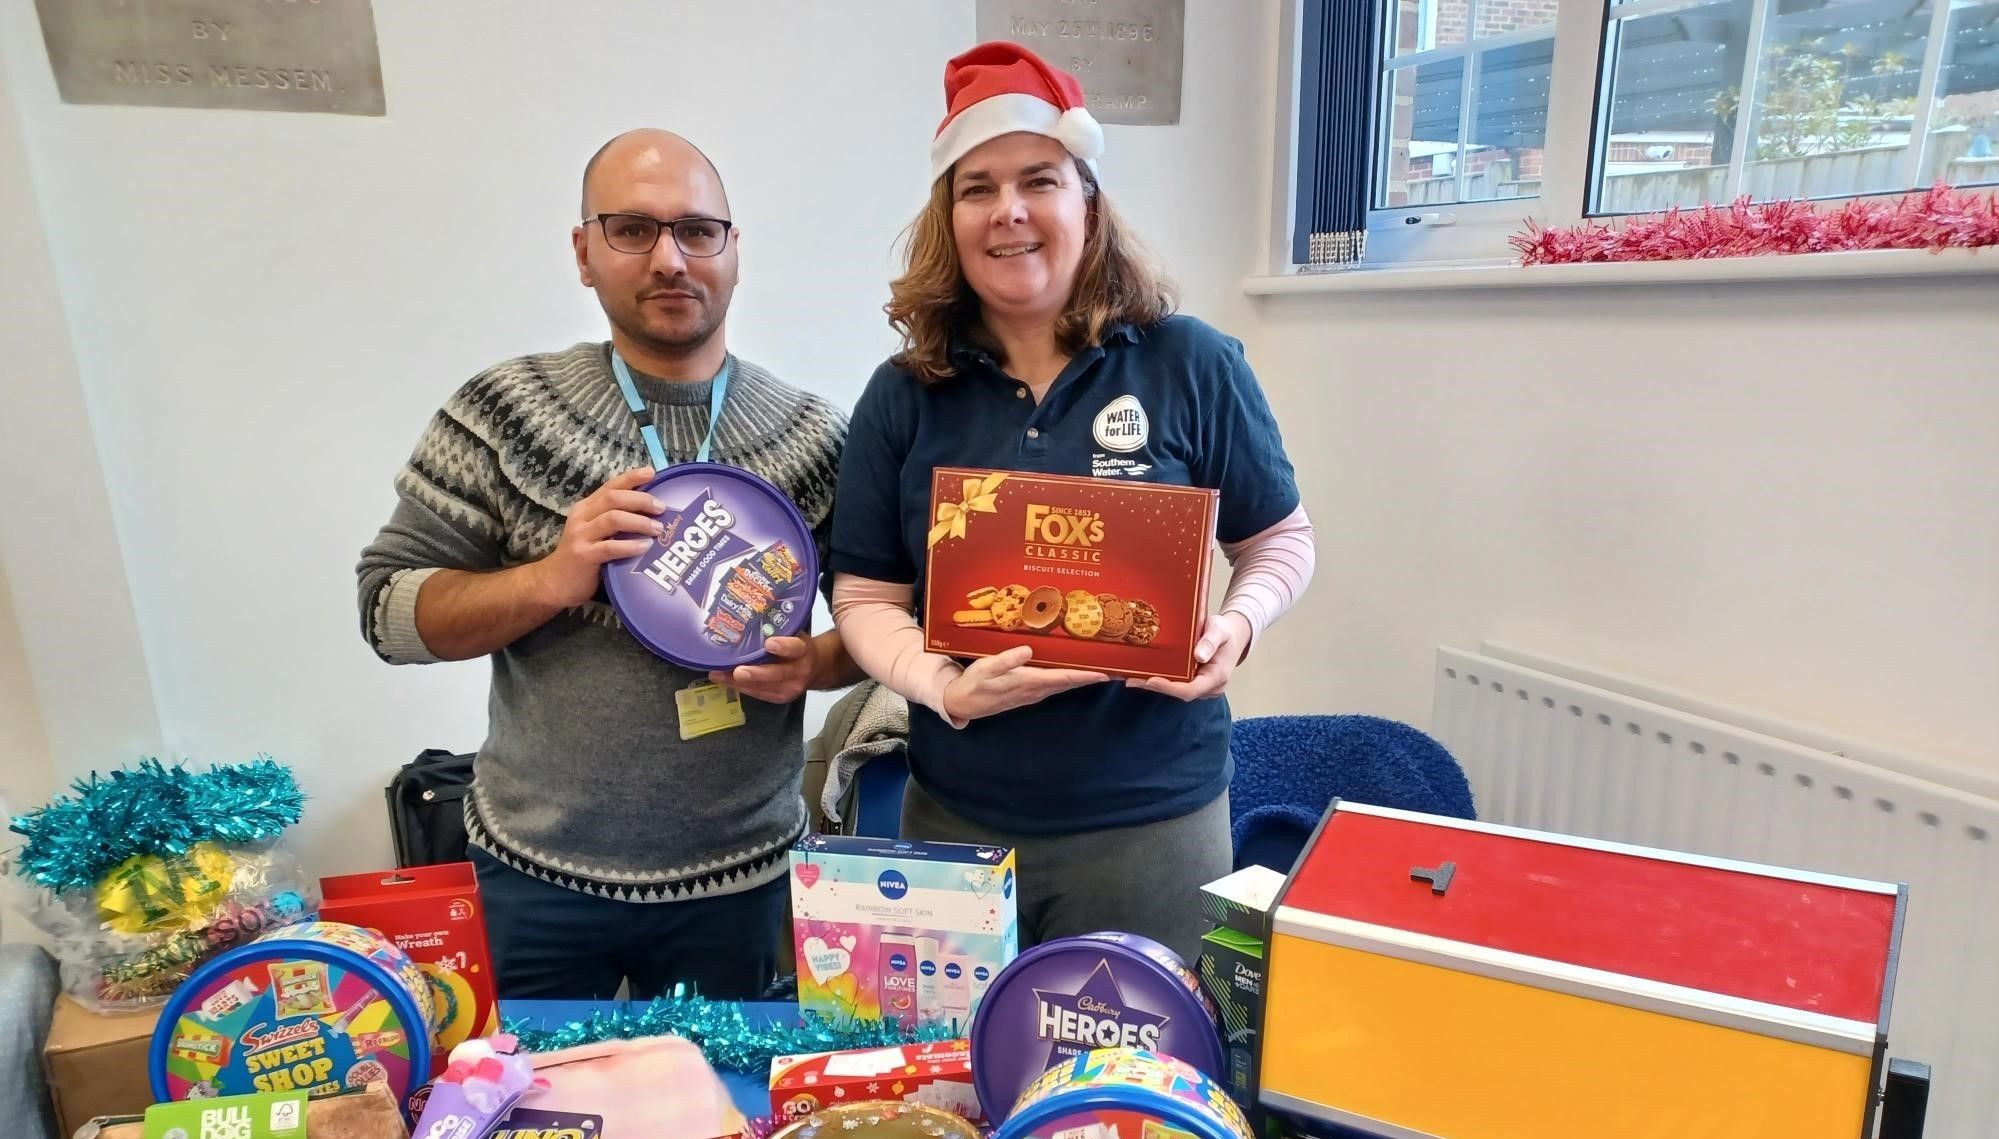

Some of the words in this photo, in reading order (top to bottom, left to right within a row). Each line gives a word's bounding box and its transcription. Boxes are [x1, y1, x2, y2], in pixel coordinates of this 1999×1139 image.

[191, 20, 235, 41] BY
[1010, 17, 1050, 37] MAY
[1071, 56, 1094, 72] BY
[113, 60, 194, 85] MISS
[1106, 409, 1140, 424] WATER
[1105, 425, 1120, 436] for
[1122, 423, 1141, 436] LIFE
[1092, 458, 1135, 468] Southern
[1051, 506, 1073, 515] SINCE
[643, 499, 736, 595] HEROES
[1025, 545, 1101, 562] CLASSIC
[684, 565, 702, 586] SHARE
[699, 549, 717, 569] GOOD
[713, 534, 731, 552] TIMES
[1023, 564, 1054, 573] BISCUIT
[1056, 567, 1100, 577] SELECTION
[879, 880, 906, 890] NIVEA
[855, 903, 892, 914] RAINBOW
[893, 906, 913, 916] SOFT
[914, 909, 934, 917] SKIN
[395, 937, 444, 949] Wreath
[811, 953, 840, 963] HAPPY
[1234, 961, 1262, 981] Dove
[884, 975, 915, 988] LOVE
[1077, 995, 1121, 1020] Cadbury
[1037, 1000, 1161, 1055] HEROES
[245, 1036, 325, 1074] SWEET
[253, 1057, 333, 1093] SHOP
[201, 1105, 252, 1126] BULL
[200, 1124, 252, 1139] DOG
